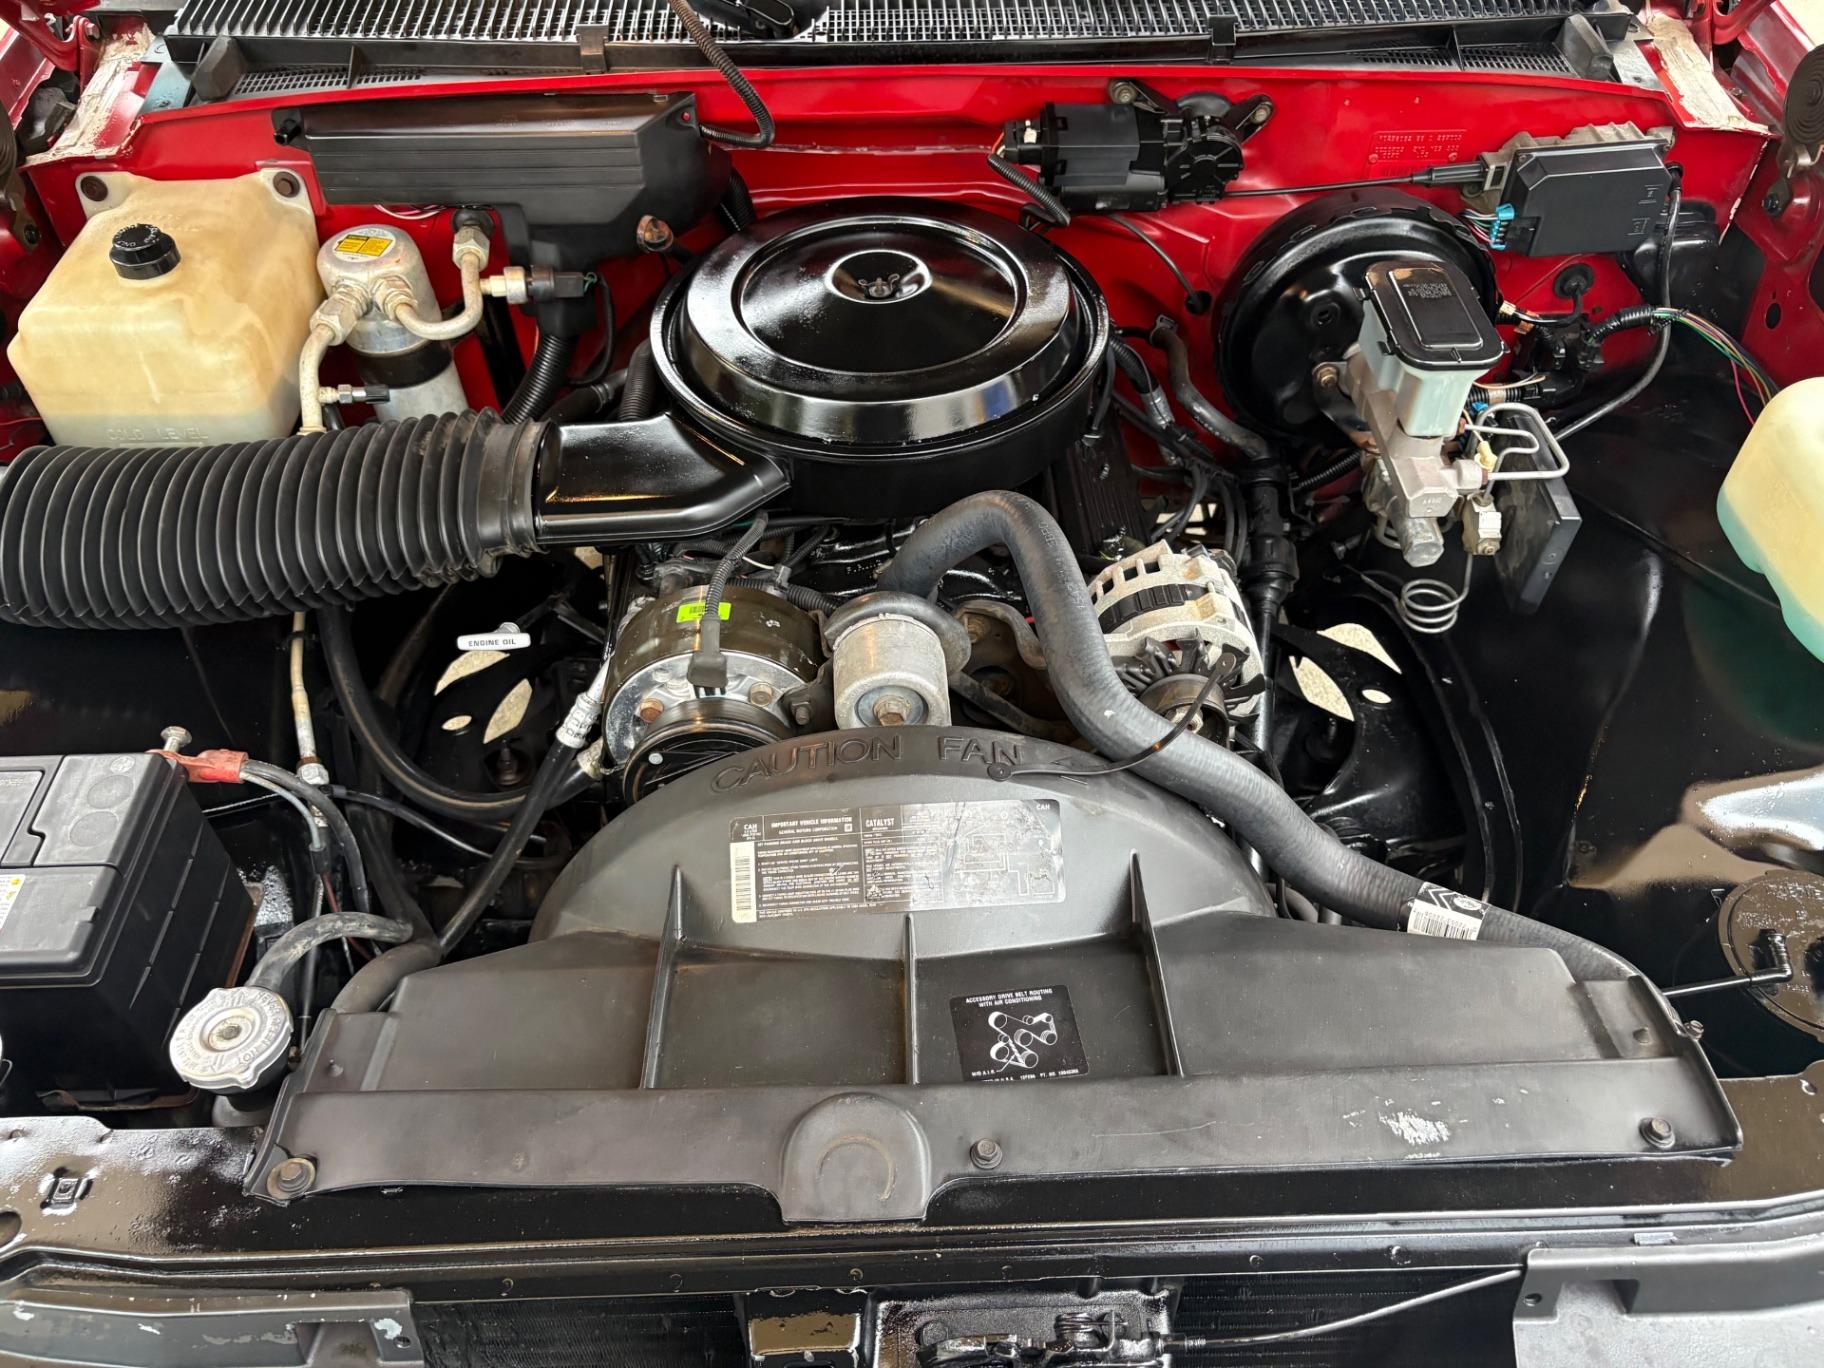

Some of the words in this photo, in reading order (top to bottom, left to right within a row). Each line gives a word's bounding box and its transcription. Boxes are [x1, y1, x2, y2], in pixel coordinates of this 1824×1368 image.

[468, 639, 499, 647] ENGINE
[711, 735, 900, 793] CAUTION
[937, 735, 1022, 767] FAN
[865, 817, 895, 828] CATALYST
[965, 995, 997, 1004] ACCESSORY
[997, 992, 1013, 1001] DRIVE
[1015, 990, 1029, 999] BELT
[1029, 988, 1053, 997] ROUTING
[979, 1000, 993, 1008] WITH
[1004, 995, 1042, 1005] CONDITIONING
